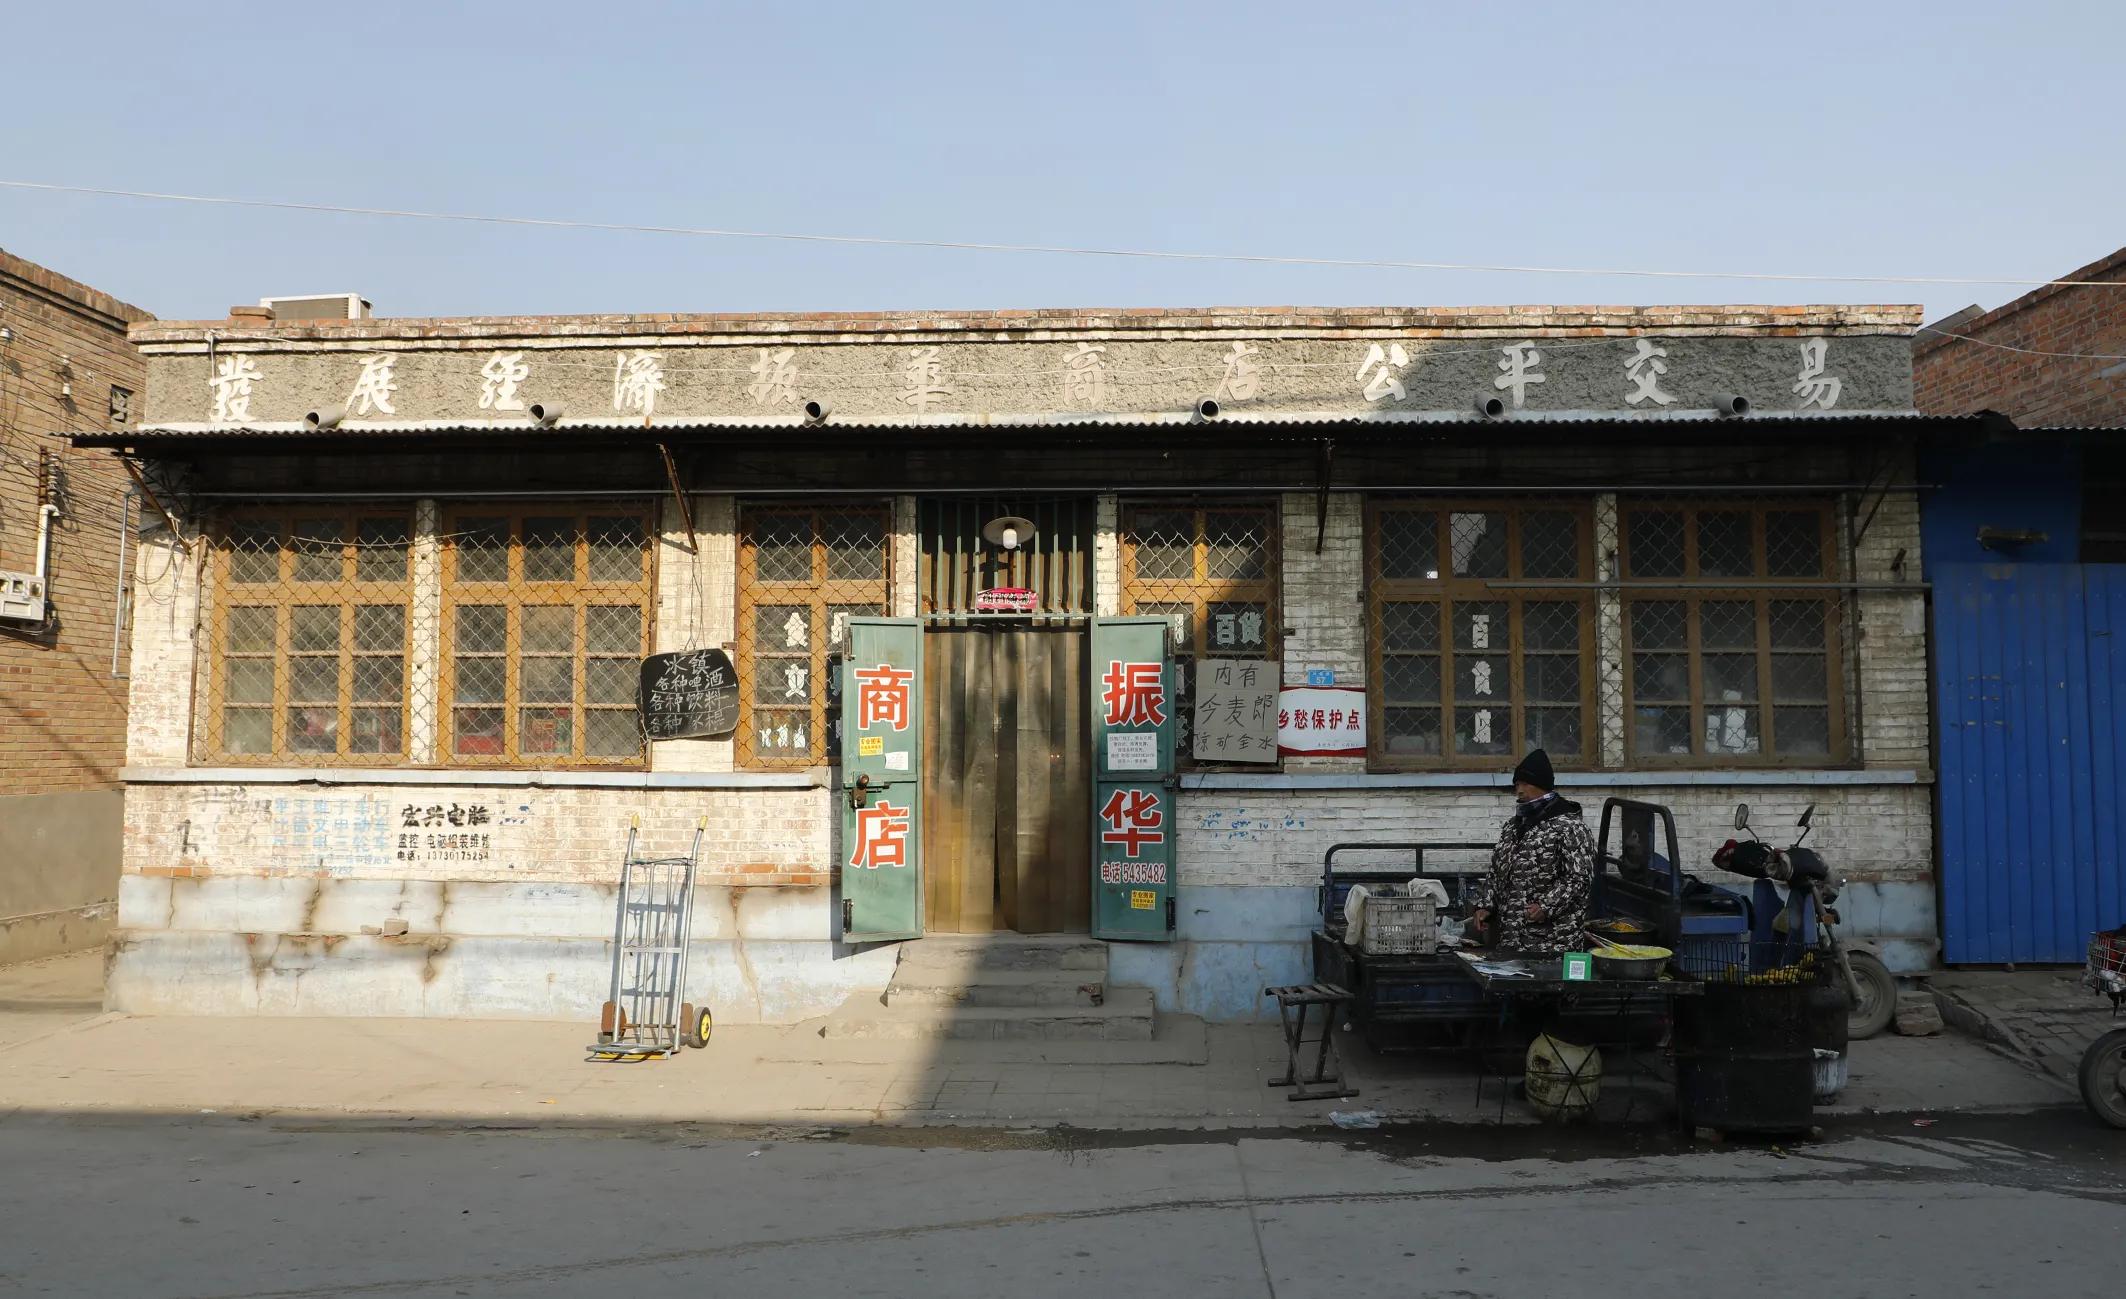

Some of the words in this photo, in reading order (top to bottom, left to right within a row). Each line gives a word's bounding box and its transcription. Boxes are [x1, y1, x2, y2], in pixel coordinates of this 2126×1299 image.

[1216, 612, 1262, 645] 百货
[663, 650, 711, 675] 冰镇
[1214, 662, 1259, 688] 内有
[655, 667, 724, 692] 各种啤酒
[1199, 692, 1273, 731] 今麦郎
[1278, 708, 1360, 730] 乡愁保护点
[1100, 660, 1167, 858] 振华
[401, 802, 490, 828] 宏兴电脑
[397, 833, 419, 849] 监控
[1101, 861, 1121, 883] 电话
[1122, 862, 1166, 884] 5435482
